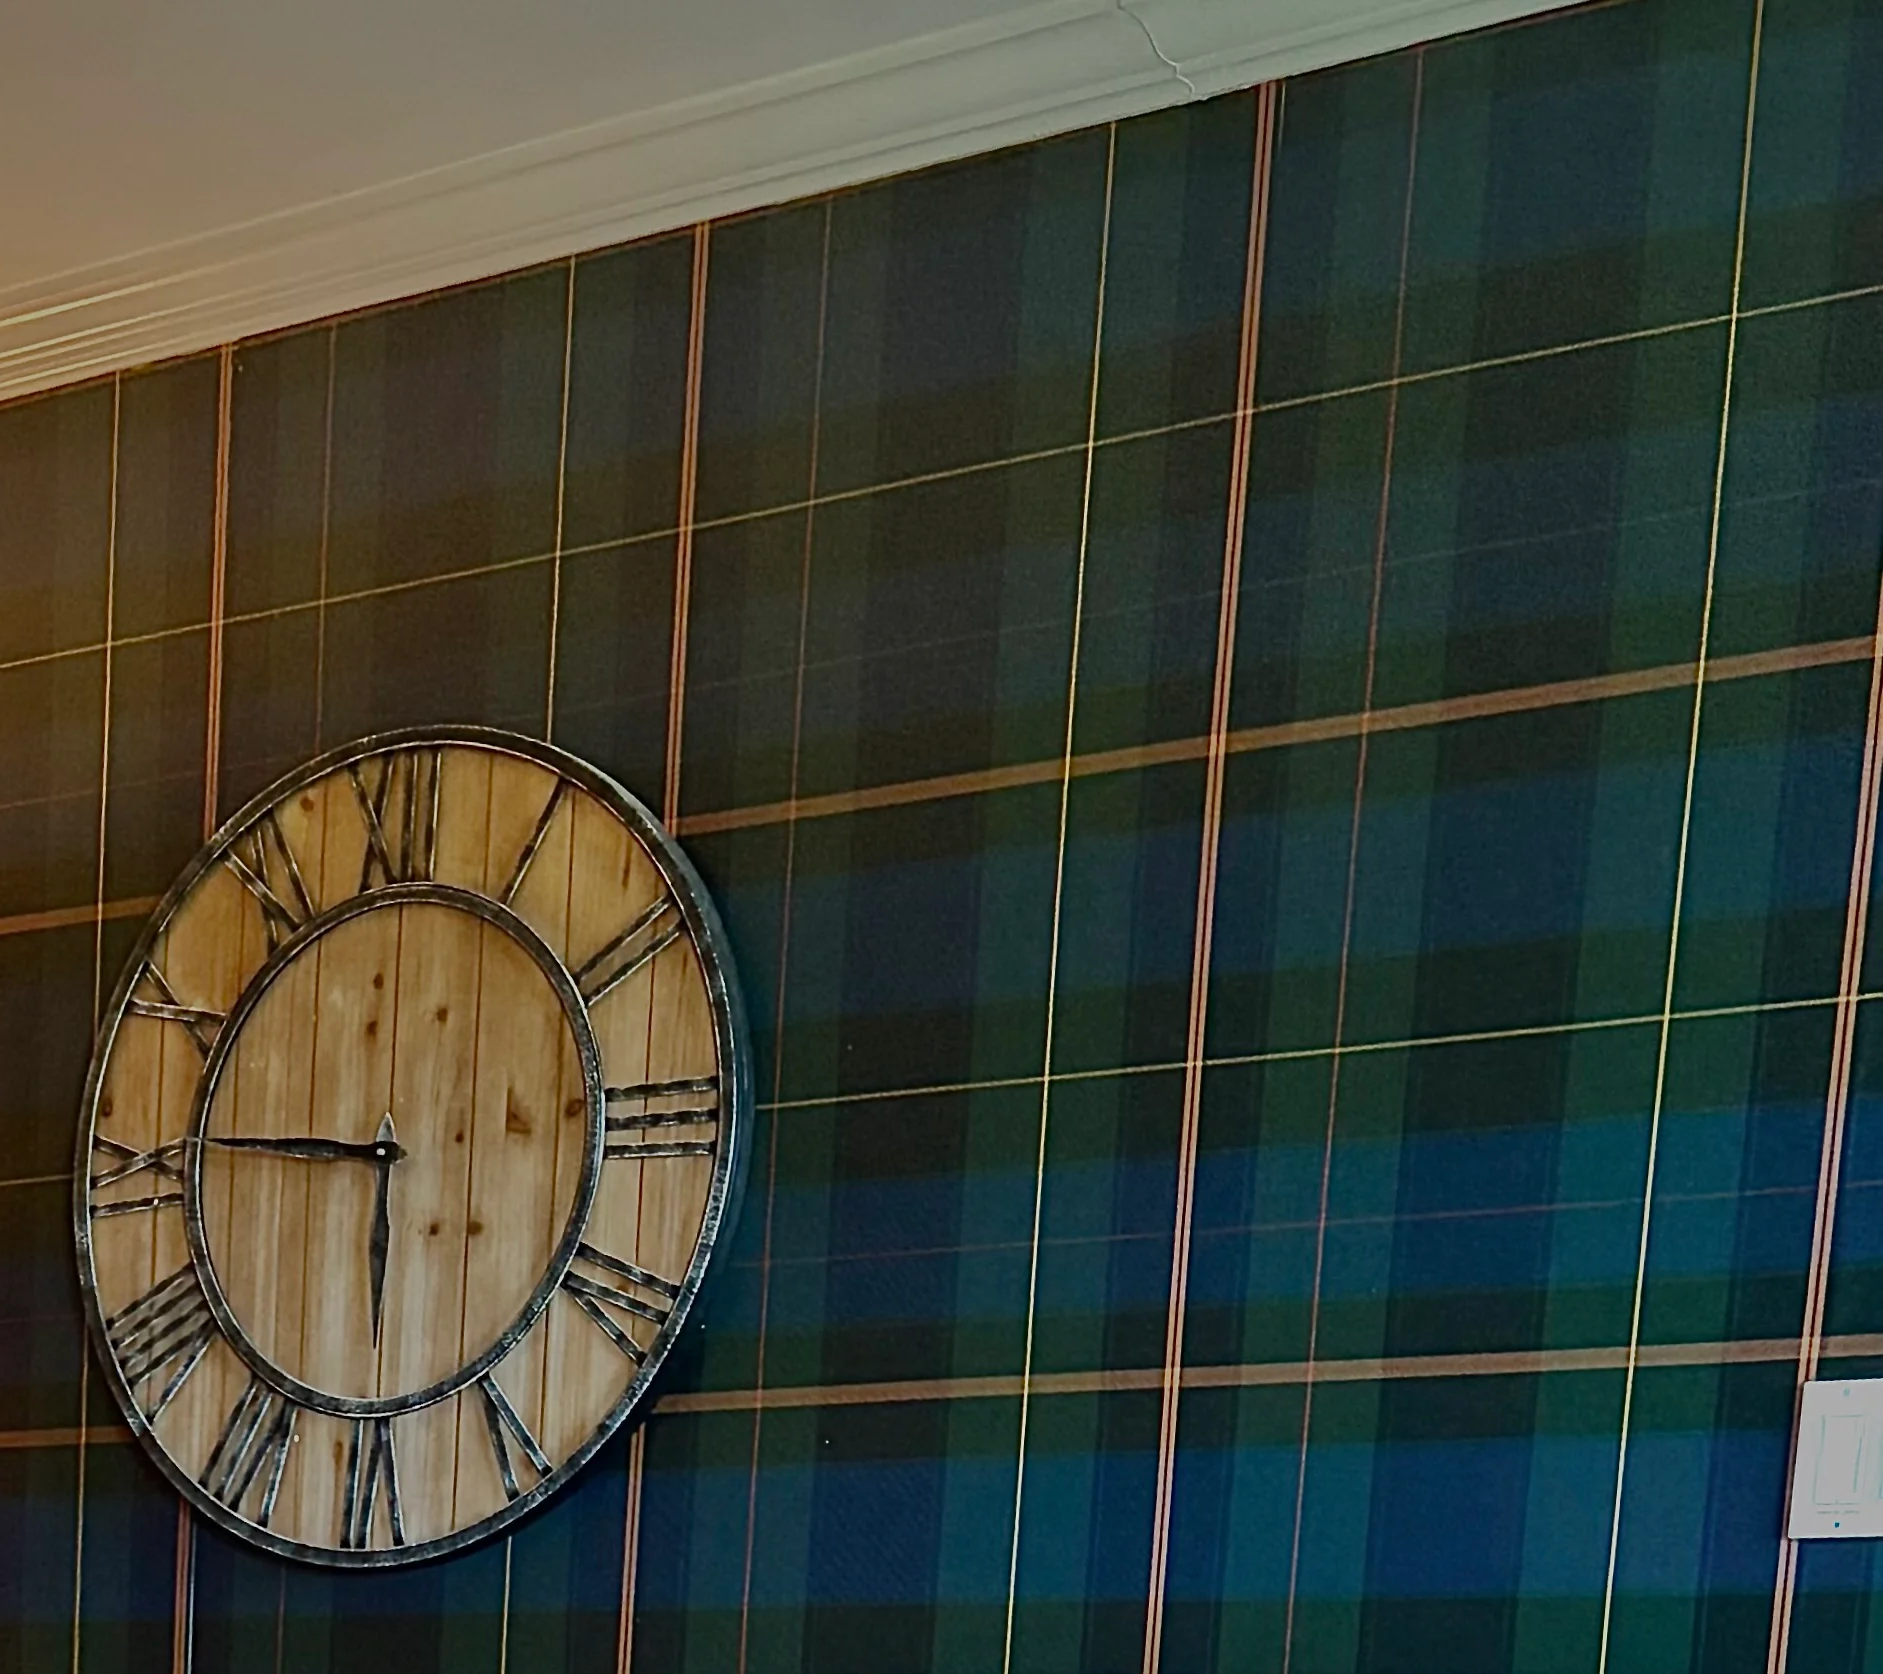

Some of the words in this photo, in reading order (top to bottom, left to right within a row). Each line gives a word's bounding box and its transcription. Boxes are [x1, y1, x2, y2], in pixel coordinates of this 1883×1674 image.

[348, 747, 443, 892] XII
[573, 894, 684, 1006] II
[127, 958, 229, 1058] X
[605, 1075, 720, 1160] III
